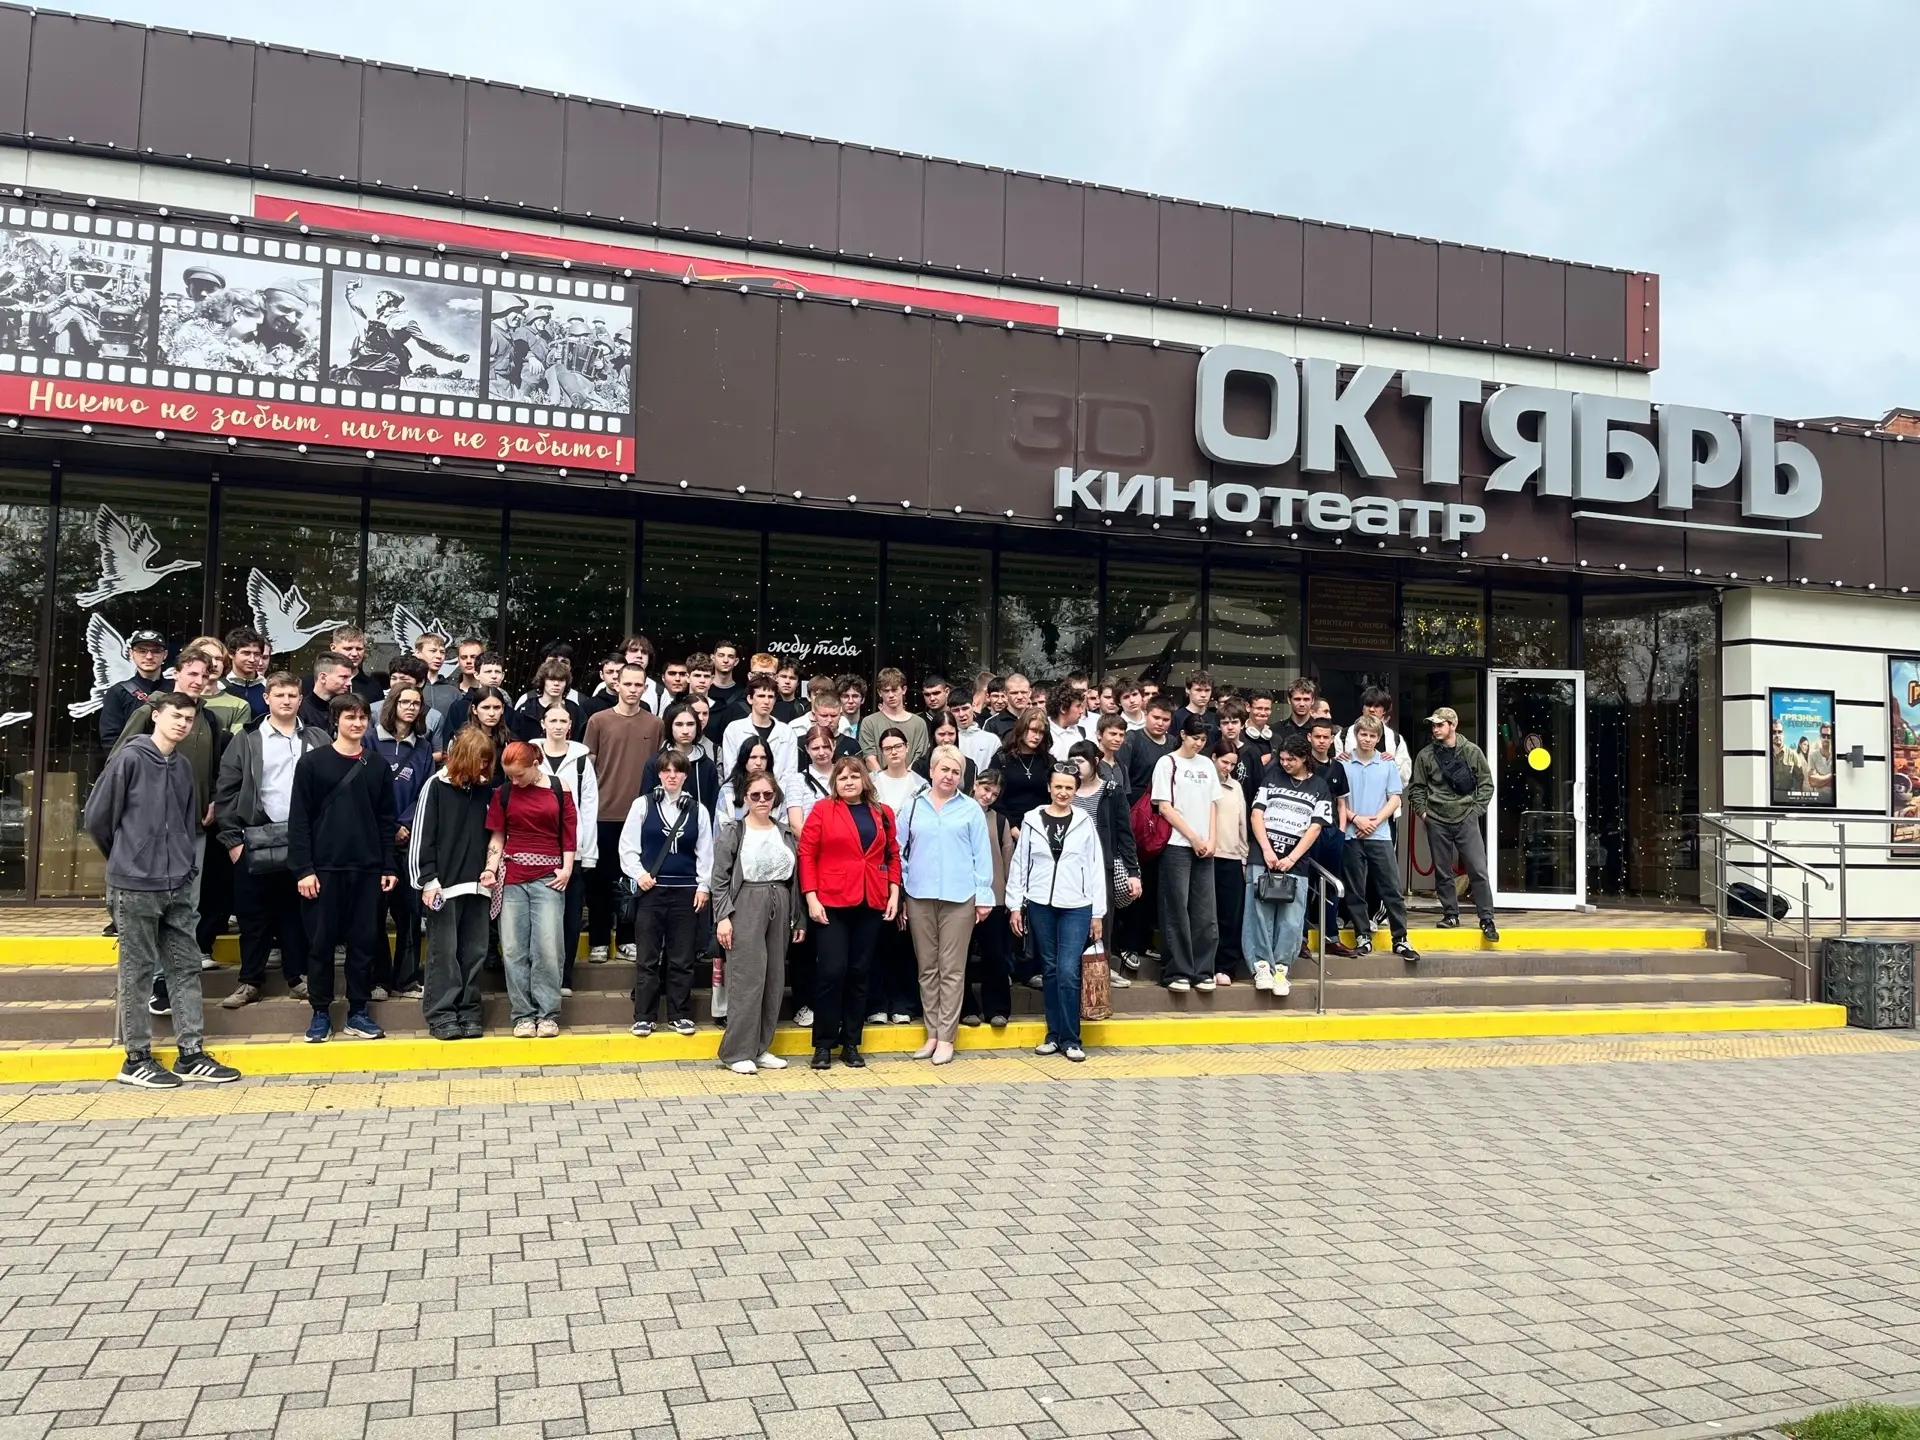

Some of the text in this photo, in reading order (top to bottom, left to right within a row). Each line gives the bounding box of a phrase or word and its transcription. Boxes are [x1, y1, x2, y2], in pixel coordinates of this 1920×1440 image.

[29, 380, 149, 413] Никто
[160, 401, 198, 421] не
[341, 419, 443, 442] ничто
[453, 430, 486, 449] не
[498, 432, 622, 466] забыто!
[1195, 344, 1823, 520] ОКТЯБРЬ
[768, 634, 862, 660] жду тебя
[1779, 713, 1822, 722] ГРЯЗНЫЕ
[1269, 816, 1302, 829] CHICAGO
[1273, 841, 1286, 854] 23
